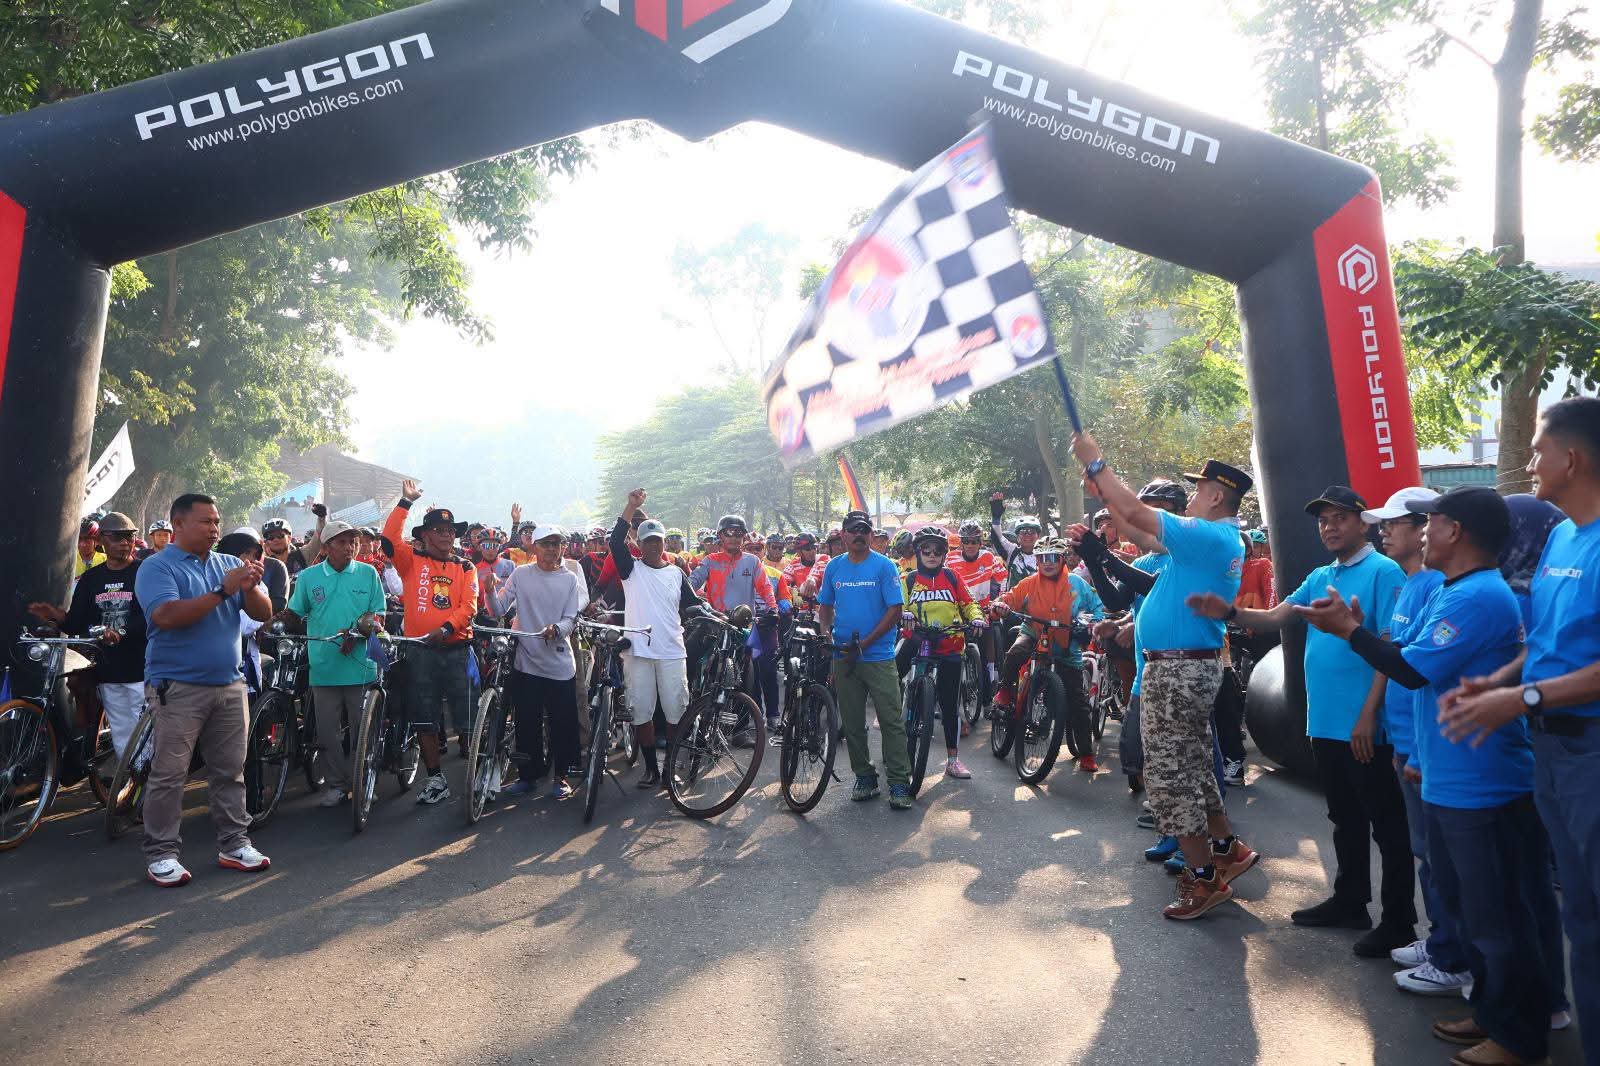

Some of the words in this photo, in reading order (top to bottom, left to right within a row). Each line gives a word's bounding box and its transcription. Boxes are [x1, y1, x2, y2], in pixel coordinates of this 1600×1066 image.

[134, 32, 435, 141] POLYGON
[187, 77, 404, 151] www.polygonbikes.com
[952, 50, 1221, 164] POLYGON
[983, 96, 1177, 173] www.polygonbikes.com
[1358, 305, 1395, 470] POLYGON
[909, 589, 955, 604] PADATI
